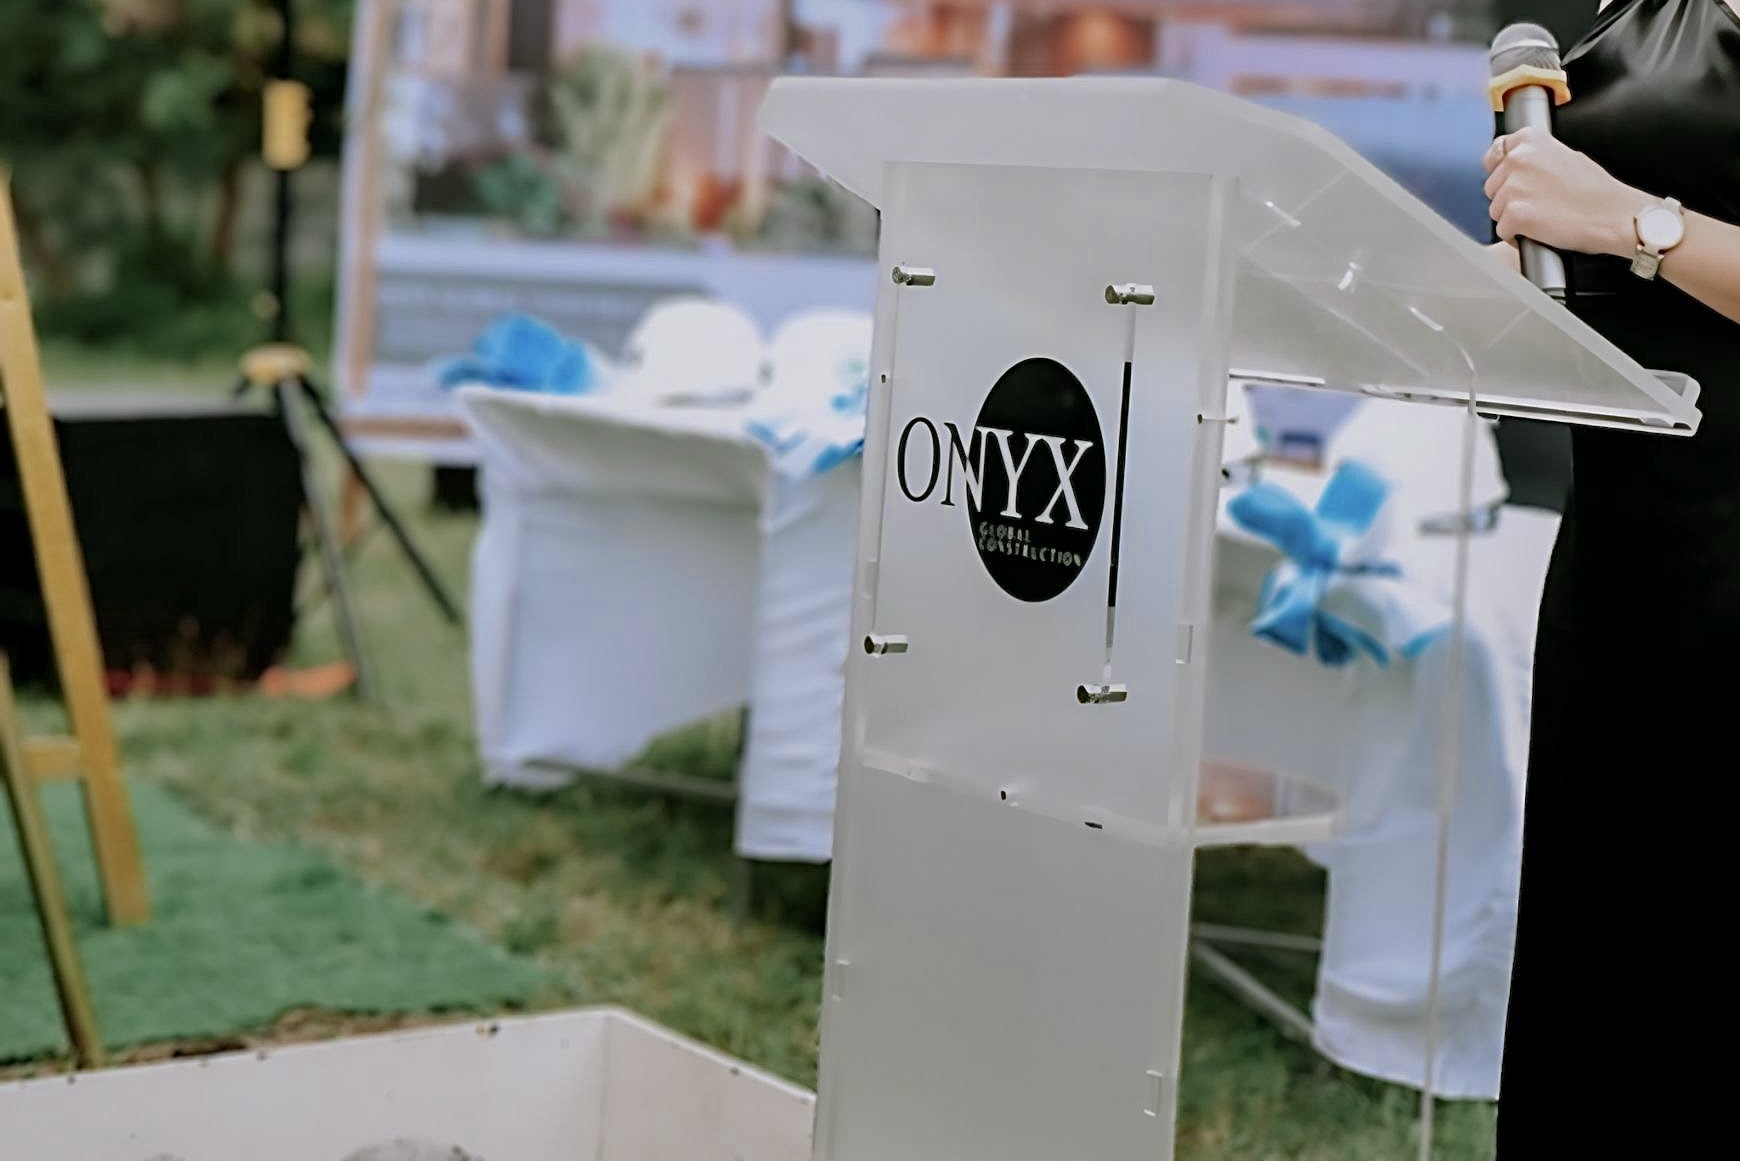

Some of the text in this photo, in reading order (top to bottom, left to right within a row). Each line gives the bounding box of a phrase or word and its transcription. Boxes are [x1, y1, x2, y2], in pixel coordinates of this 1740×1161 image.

[897, 416, 1094, 531] ONYX
[979, 521, 1031, 543] GLOBAL
[978, 538, 1082, 567] CONSTRUCTION
